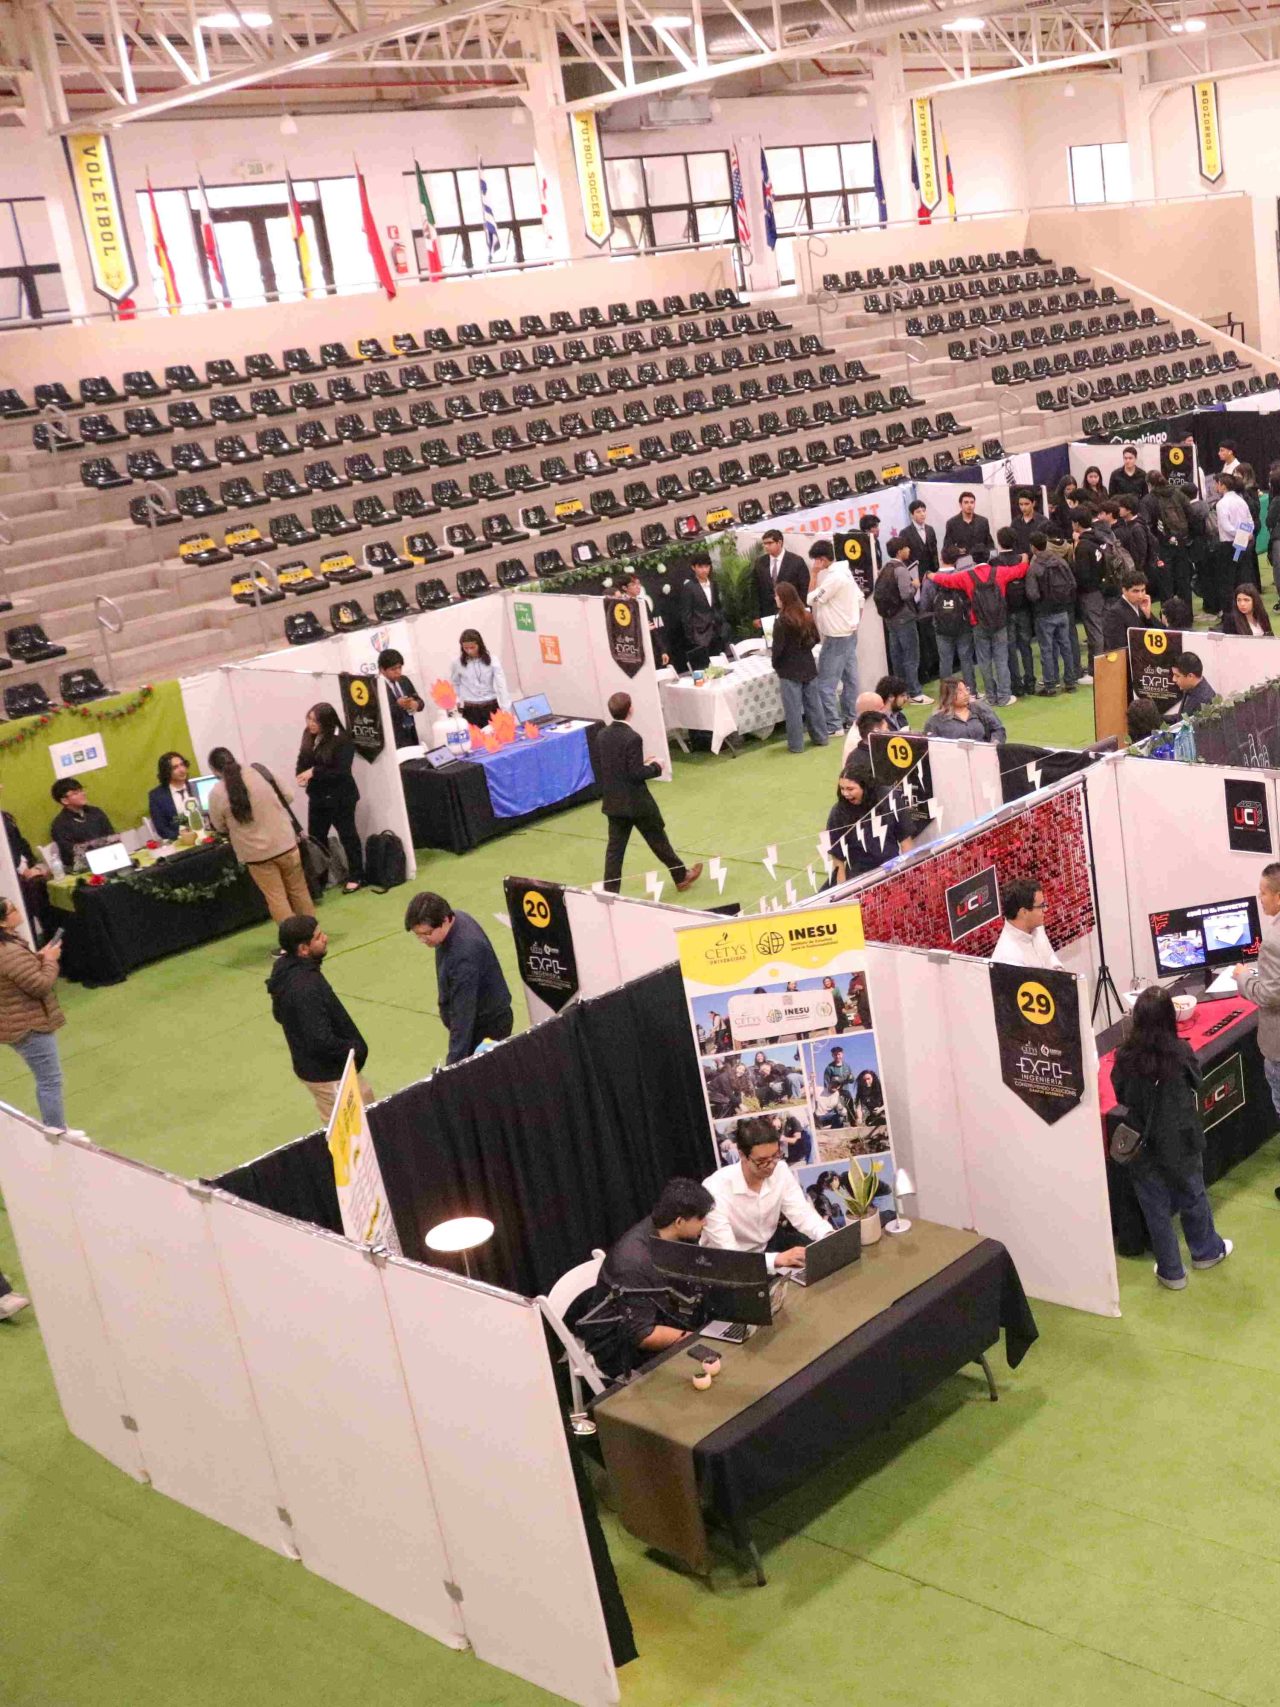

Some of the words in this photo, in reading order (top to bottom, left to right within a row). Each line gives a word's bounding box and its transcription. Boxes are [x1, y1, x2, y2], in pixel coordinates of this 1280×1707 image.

[918, 105, 929, 152] FUTBOL
[580, 119, 595, 168] FUTBOL
[588, 171, 601, 218] SOCCER
[82, 145, 117, 257] VOLEIBOL
[1174, 452, 1179, 460] 6
[849, 545, 856, 554] 4
[619, 609, 625, 620] 3
[1148, 634, 1163, 648] 18
[356, 687, 363, 699] 2
[891, 745, 908, 760] 19
[525, 900, 548, 919] 20
[788, 923, 837, 941] INESU
[704, 943, 747, 961] CETYS
[784, 1006, 810, 1015] INESU
[1020, 992, 1051, 1015] 29
[1016, 1057, 1072, 1079] EXPO
